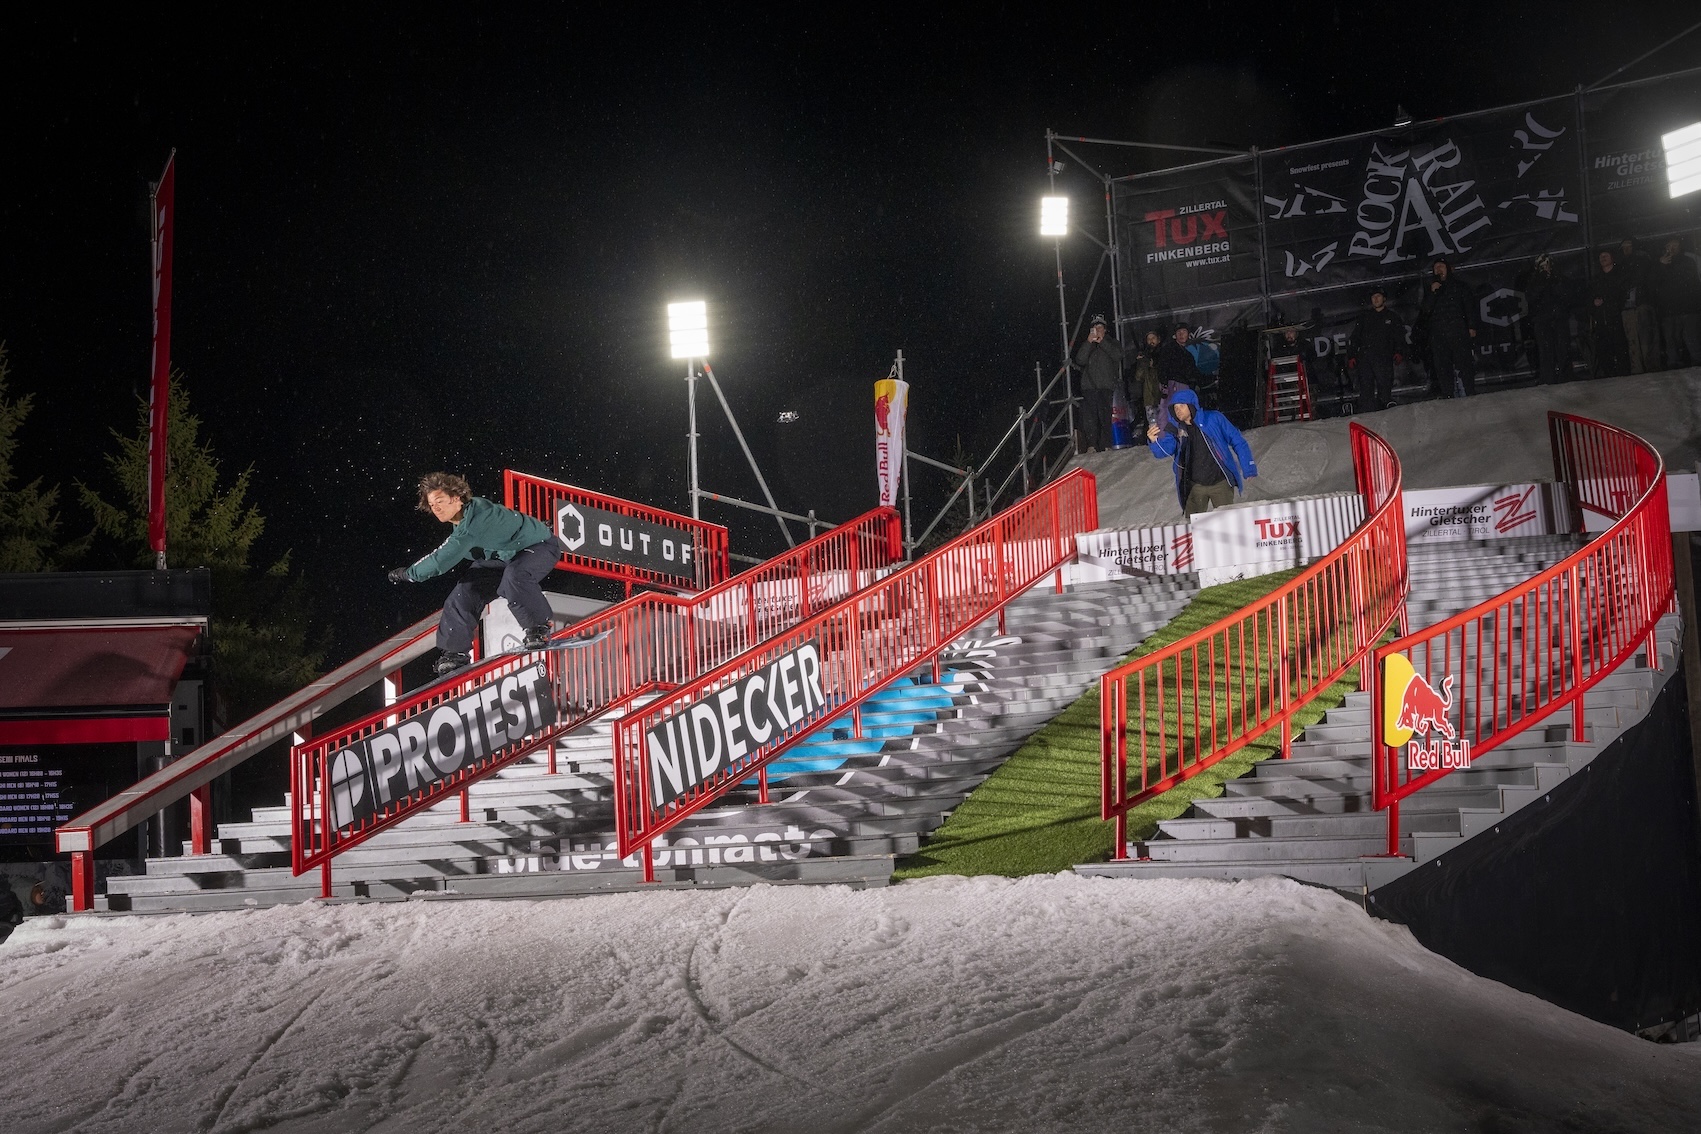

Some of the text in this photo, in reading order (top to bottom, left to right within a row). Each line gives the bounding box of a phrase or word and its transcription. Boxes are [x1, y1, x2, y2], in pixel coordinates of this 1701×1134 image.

[1594, 148, 1662, 169] Hintertu
[1290, 159, 1350, 175] Snowfest presents
[1347, 142, 1410, 258] ROCK
[1411, 138, 1492, 254] RAIL
[1179, 200, 1227, 215] ZILLERTAL
[1146, 241, 1230, 263] FINKENBERG
[1185, 254, 1230, 268] www.tux.at
[878, 442, 890, 502] Red Bull
[1411, 505, 1487, 517] Hintertuxer
[1430, 514, 1491, 526] Gletscher
[1422, 527, 1490, 537] ZILLERTAL TIROL
[598, 523, 691, 564] OUT OF
[1099, 544, 1165, 558] Hintertuxer
[1114, 553, 1169, 566] Gletscher
[647, 644, 825, 808] NIDECKER
[14, 755, 38, 763] FINALS
[1409, 740, 1470, 769] Red Bull
